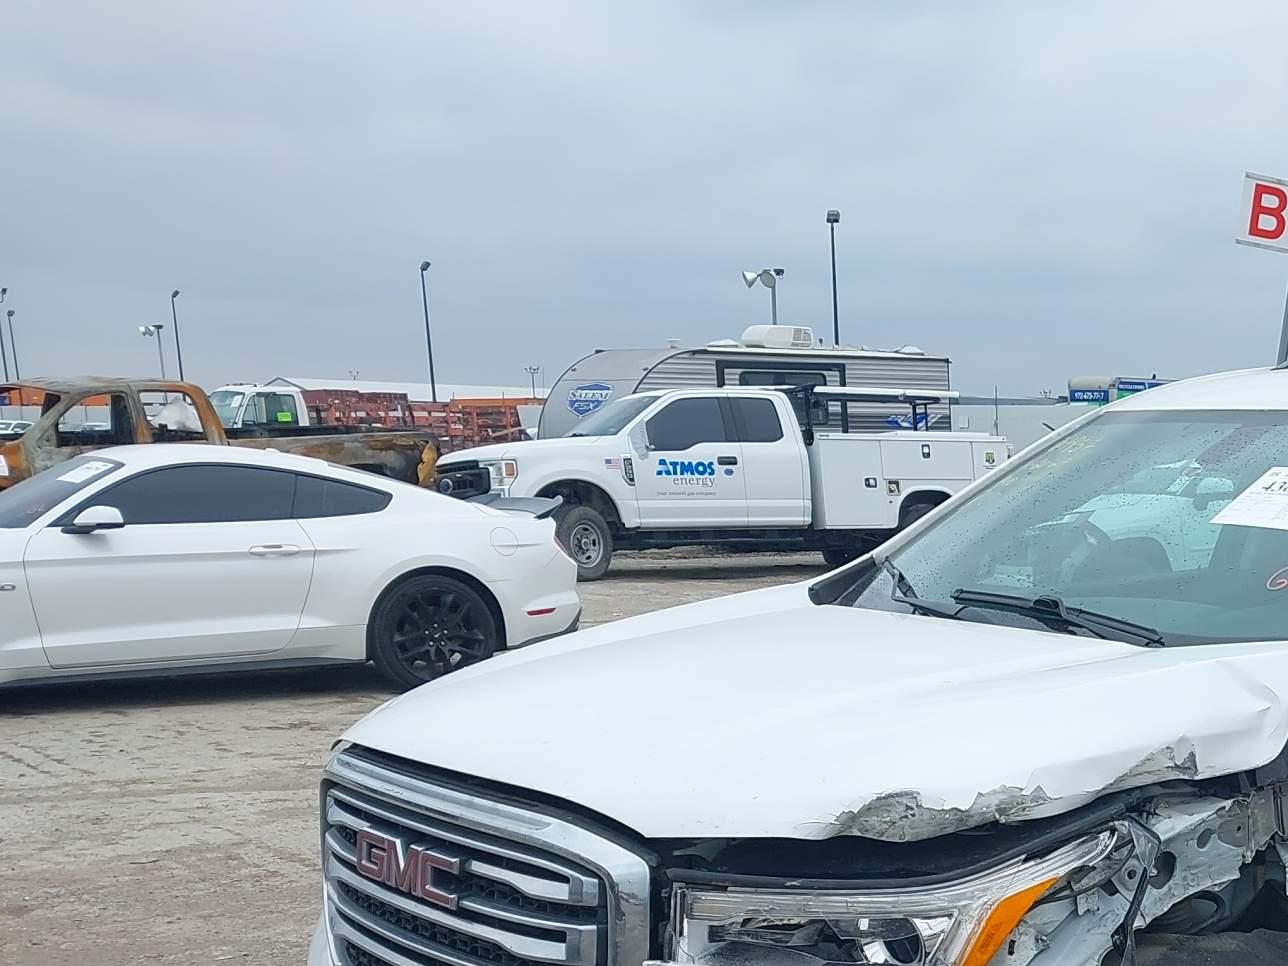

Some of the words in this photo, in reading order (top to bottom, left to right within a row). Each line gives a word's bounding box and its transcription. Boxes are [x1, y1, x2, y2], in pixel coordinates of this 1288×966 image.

[1247, 182, 1288, 240] B
[656, 458, 716, 476] ATMOS
[672, 476, 716, 488] energy
[356, 826, 460, 911] GMC
